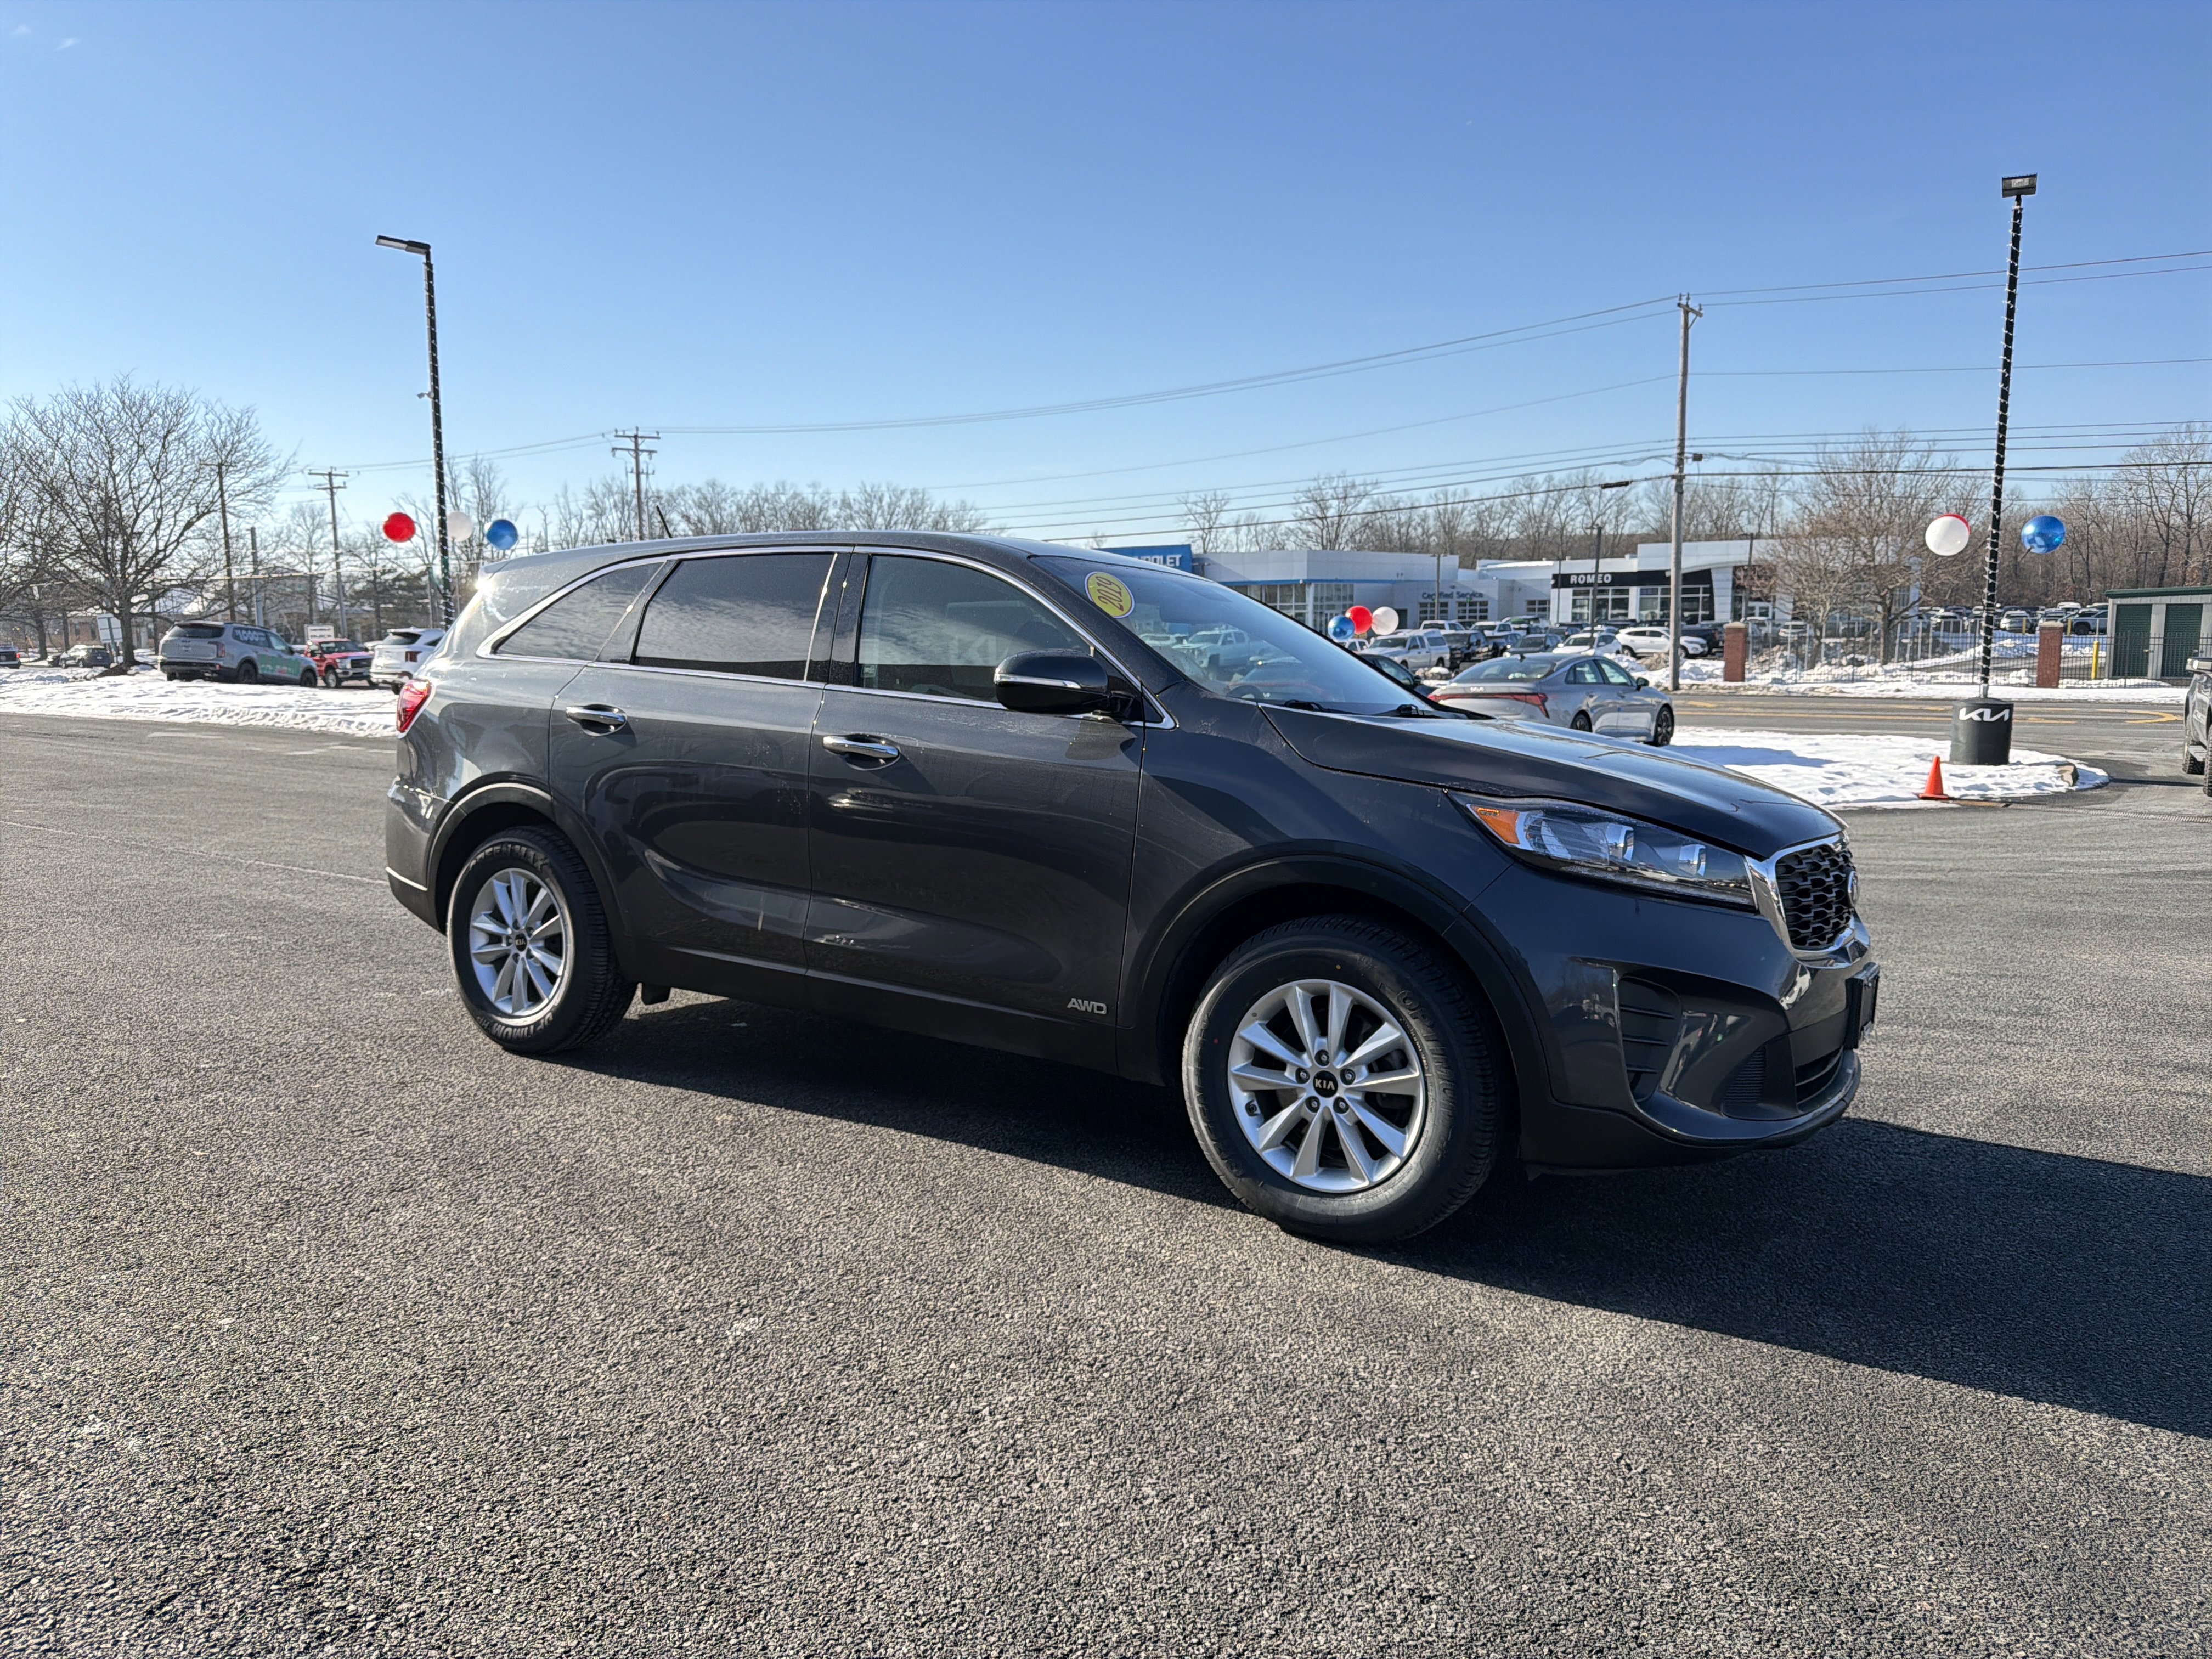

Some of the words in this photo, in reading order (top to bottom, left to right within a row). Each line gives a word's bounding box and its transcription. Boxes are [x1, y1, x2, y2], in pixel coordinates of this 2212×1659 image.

[1570, 573, 1612, 584] ROMEO
[1095, 576, 1124, 612] 2019
[1959, 707, 2010, 722] KIA
[1066, 997, 1107, 1015] AWD
[1315, 1078, 1335, 1091] KIA
